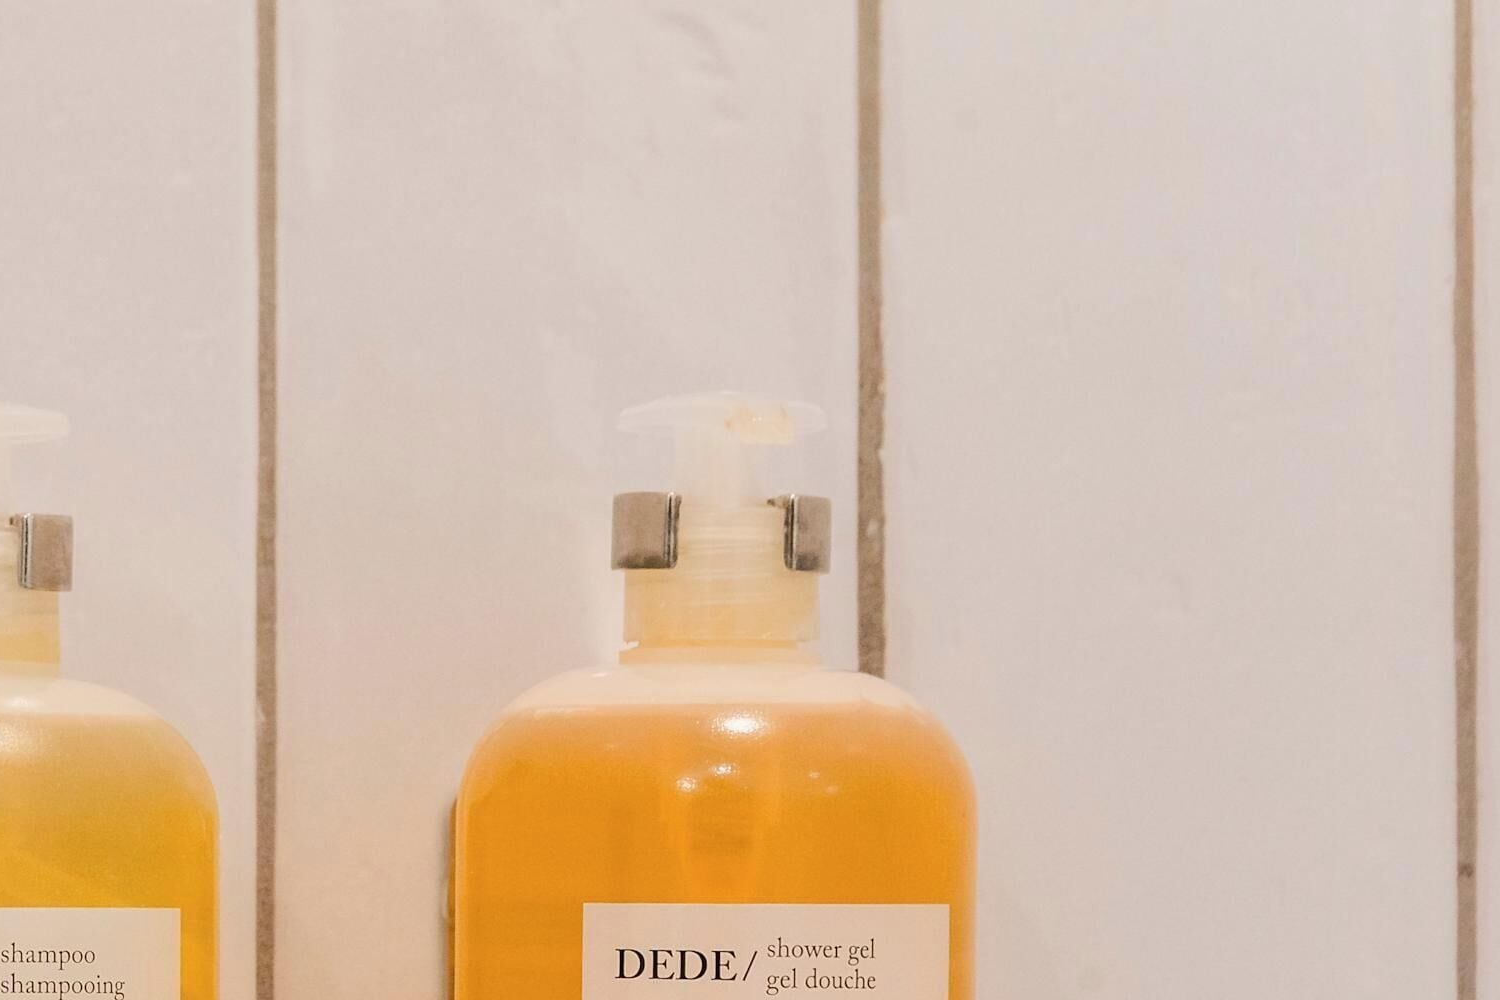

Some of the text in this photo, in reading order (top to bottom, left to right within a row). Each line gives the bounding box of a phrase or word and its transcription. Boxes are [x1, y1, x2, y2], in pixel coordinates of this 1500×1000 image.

[1, 942, 95, 970] shampoo
[768, 937, 875, 966] shower gel
[1, 973, 125, 1000] shampooing
[766, 968, 876, 995] gel douche
